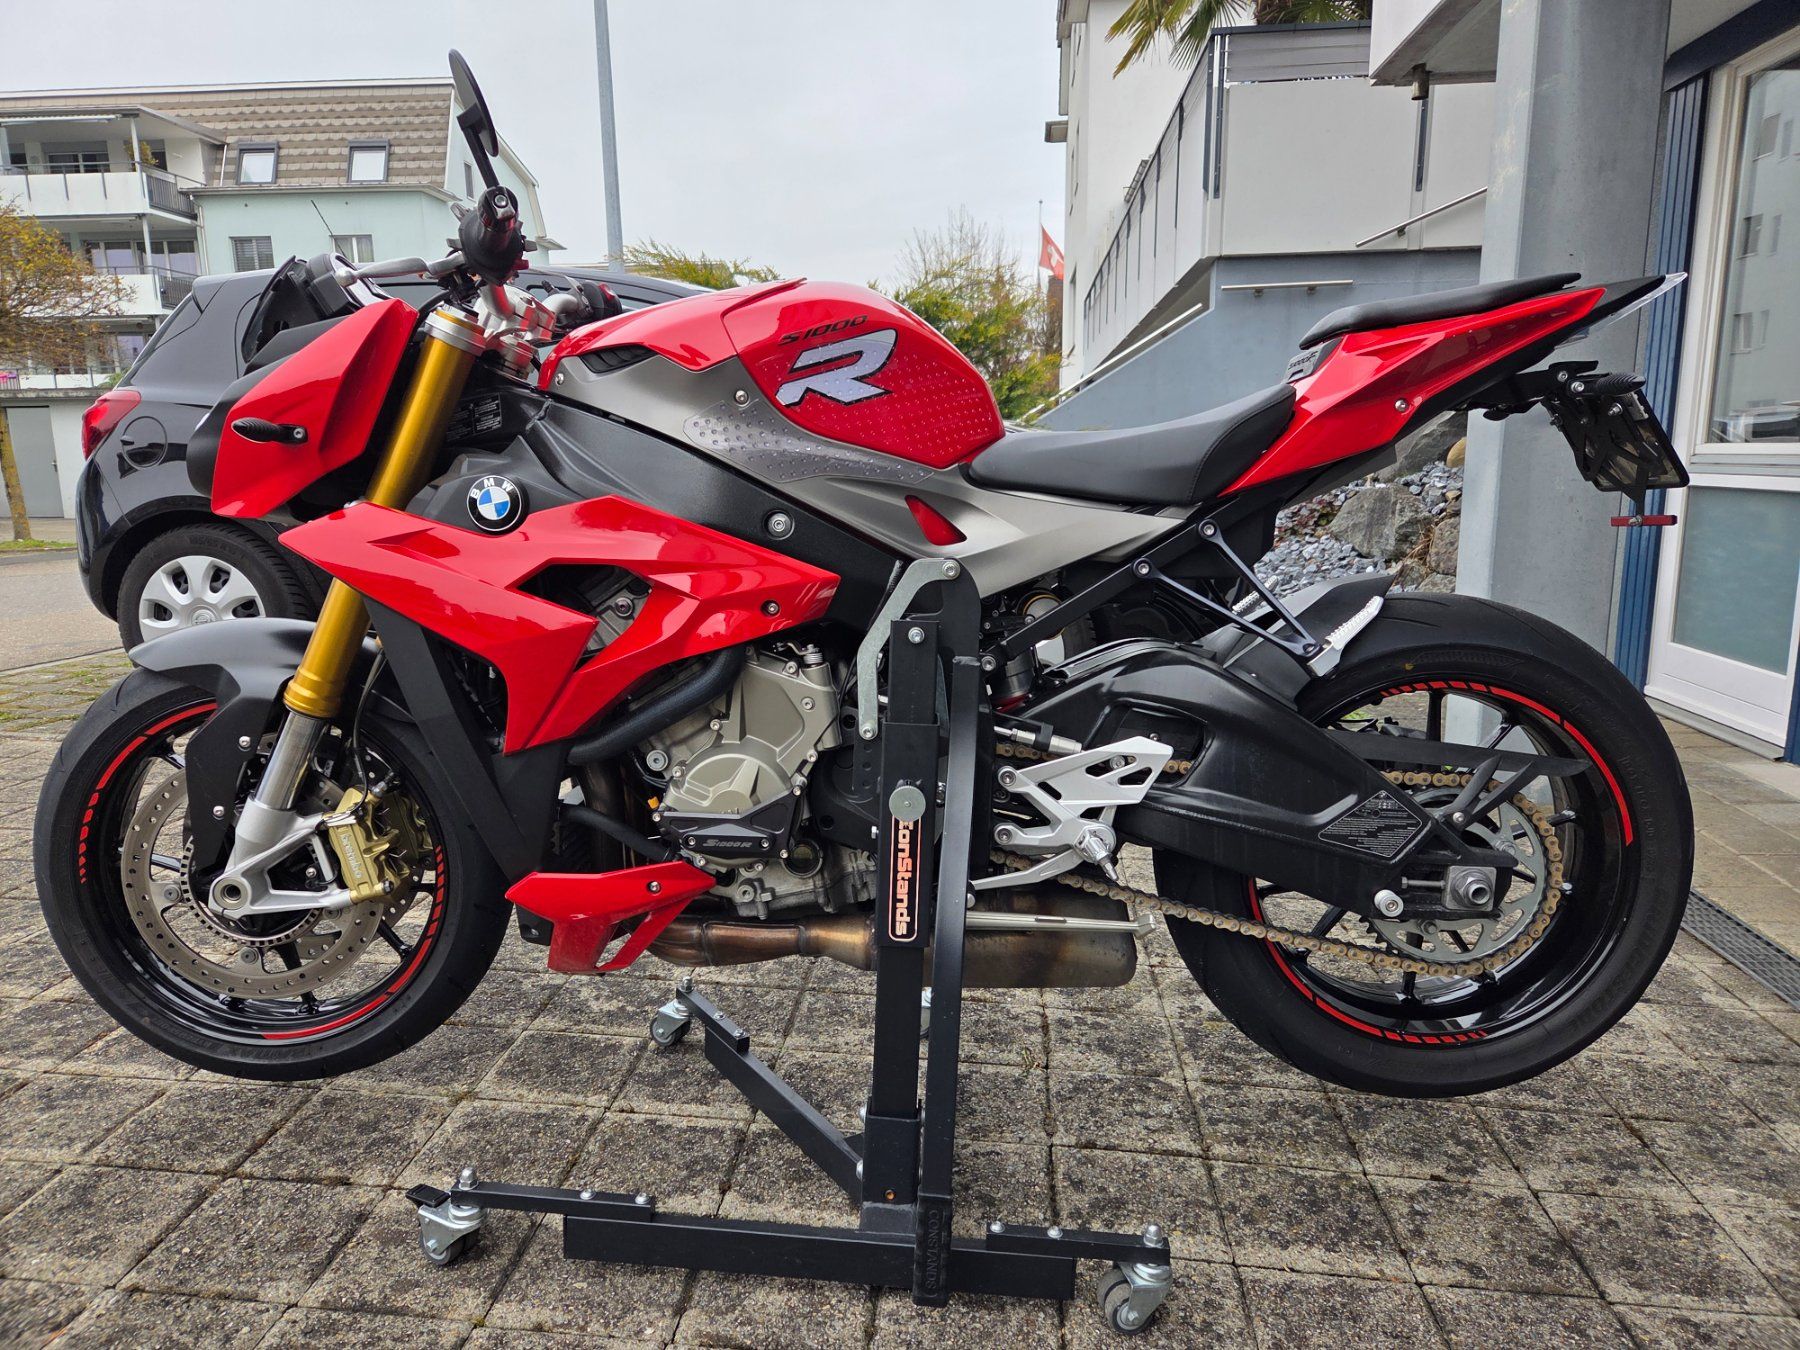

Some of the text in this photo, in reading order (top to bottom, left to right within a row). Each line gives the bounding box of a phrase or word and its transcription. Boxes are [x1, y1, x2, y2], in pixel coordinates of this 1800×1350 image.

[779, 316, 868, 345] S1000
[775, 327, 898, 406] R
[470, 478, 514, 499] BMW
[340, 833, 362, 879] brembo
[926, 1209, 941, 1290] CONSTANDS
